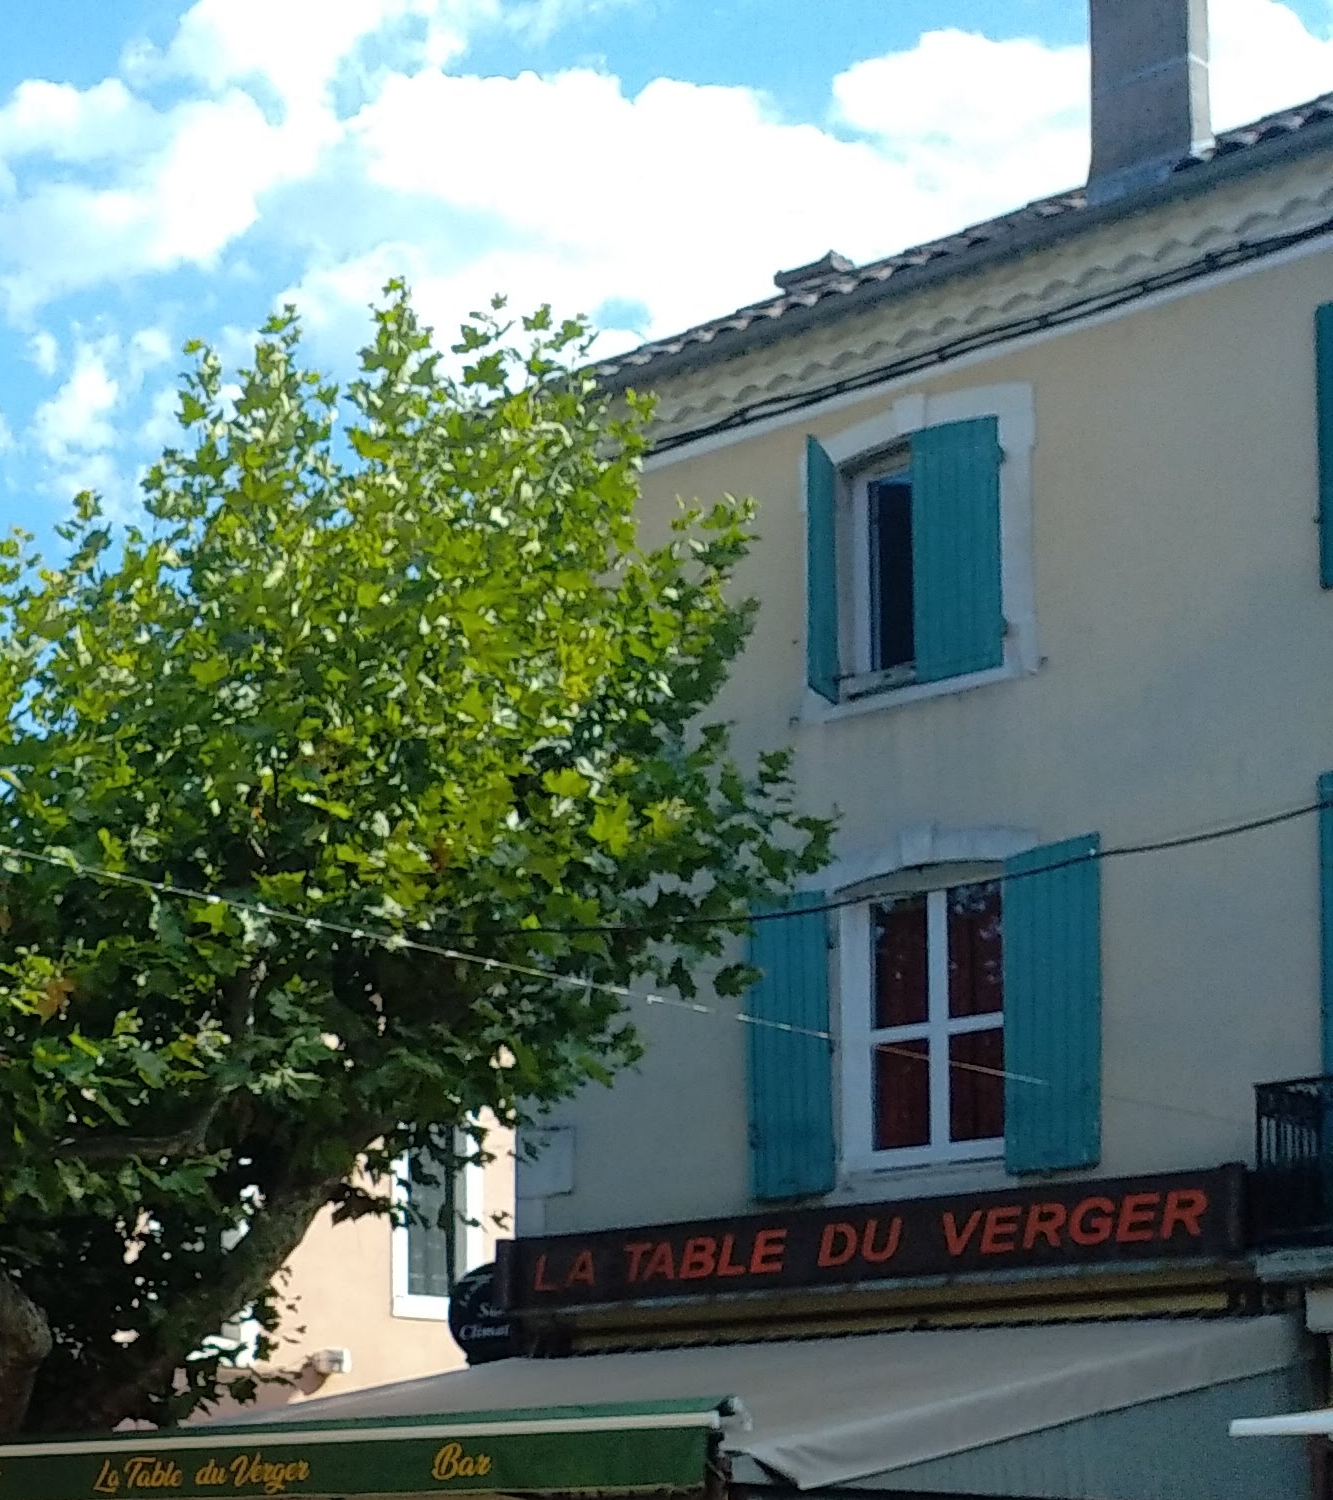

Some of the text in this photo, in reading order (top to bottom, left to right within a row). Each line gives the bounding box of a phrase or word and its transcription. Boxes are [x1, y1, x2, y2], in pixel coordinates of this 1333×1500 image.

[534, 1189, 1209, 1291] LA TABLE DU VERGER
[93, 1459, 120, 1493] La
[124, 1456, 182, 1488] Table
[196, 1458, 227, 1486] du
[231, 1452, 310, 1495] Verger
[431, 1442, 493, 1481] Bar
